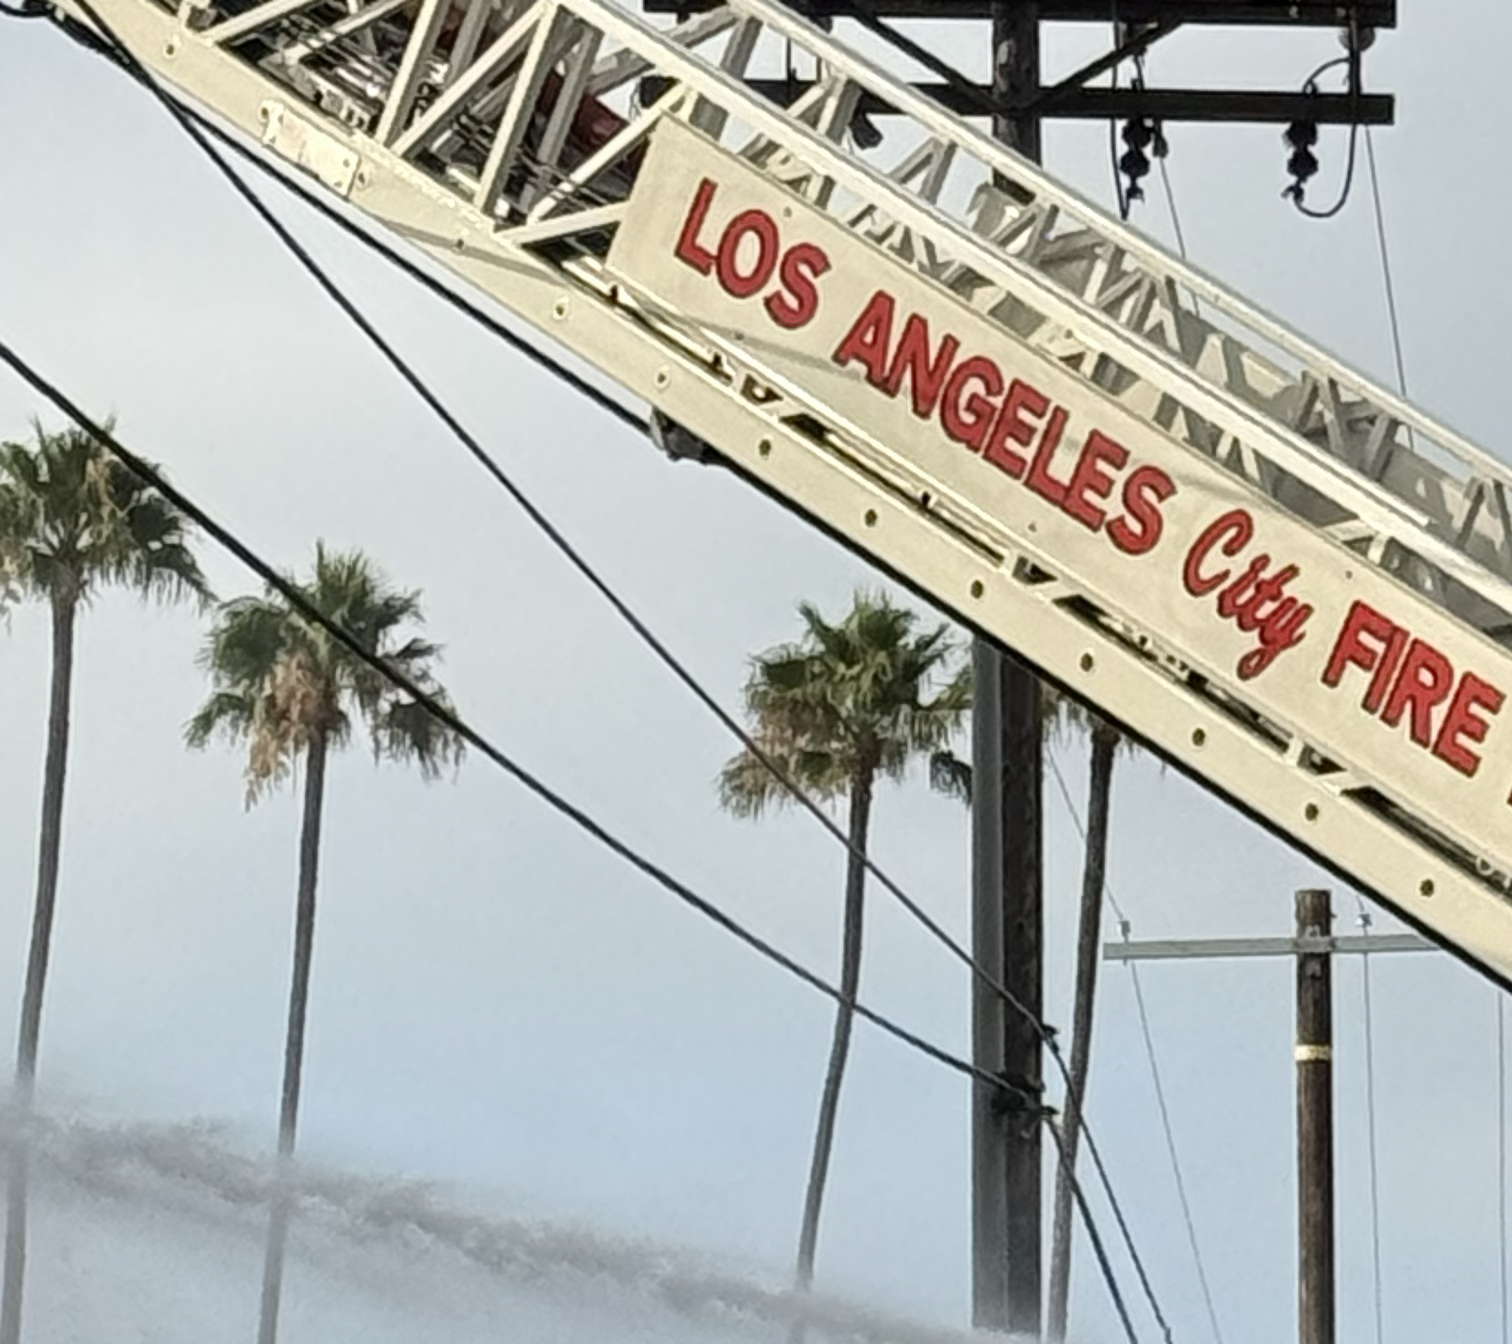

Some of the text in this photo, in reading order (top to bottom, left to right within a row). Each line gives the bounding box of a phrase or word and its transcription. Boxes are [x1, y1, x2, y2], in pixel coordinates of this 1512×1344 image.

[674, 176, 831, 331] LOS
[833, 289, 1176, 557] ANGELES
[1183, 508, 1315, 681] City
[1321, 599, 1506, 778] FIRE
